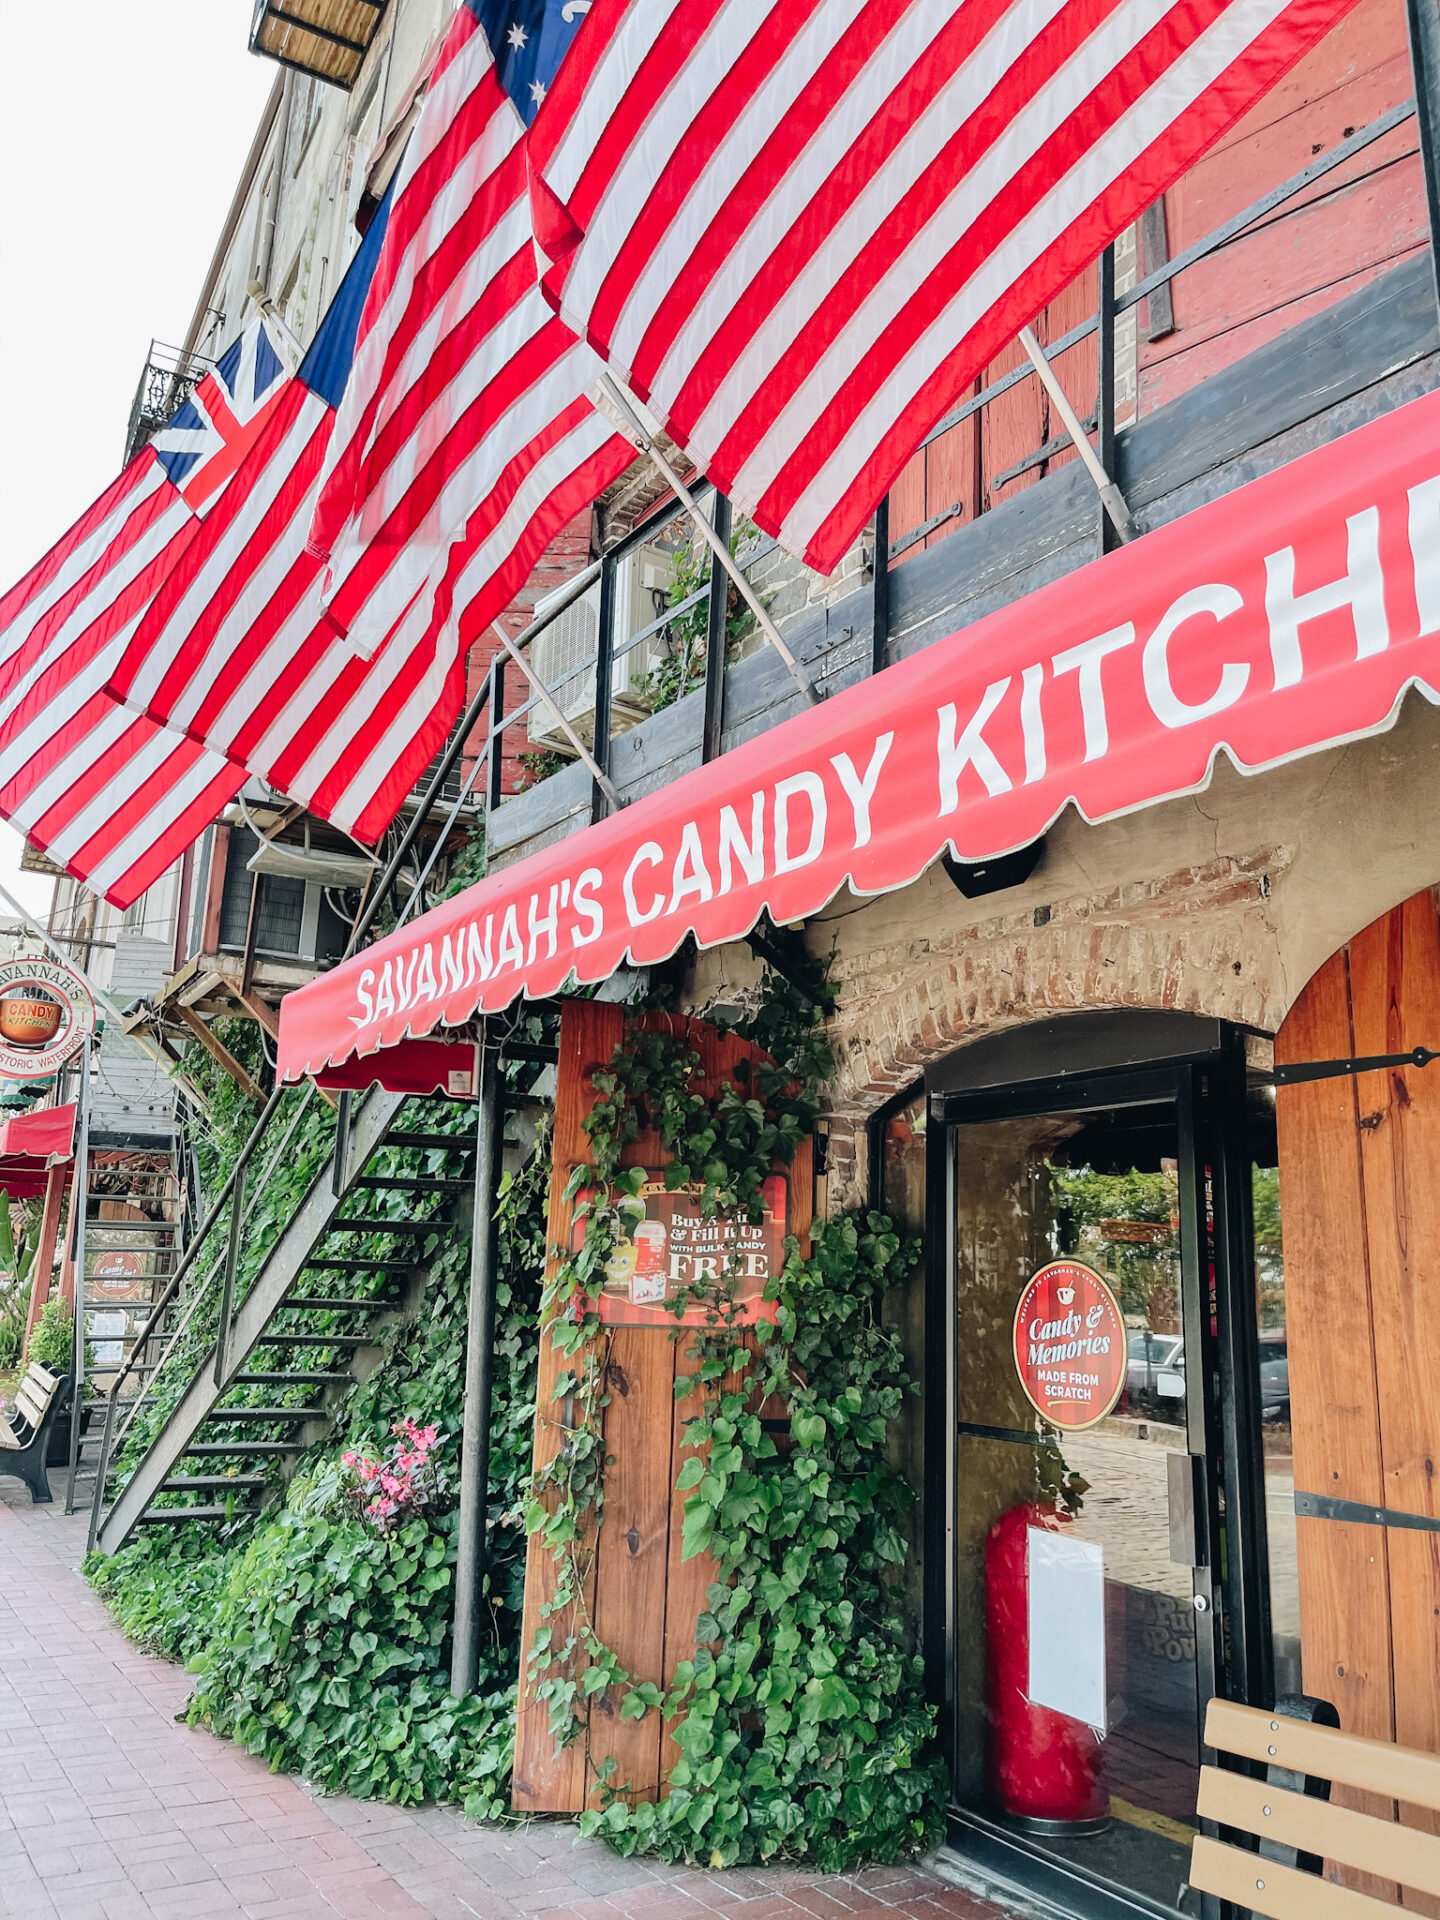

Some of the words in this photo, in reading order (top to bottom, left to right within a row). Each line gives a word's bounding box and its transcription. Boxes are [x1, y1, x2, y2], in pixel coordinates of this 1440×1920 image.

[347, 867, 604, 1029] SAVANNAH'S
[622, 731, 896, 928] CANDY
[0, 965, 83, 1000] AVANNAH'S
[9, 1003, 54, 1019] CANDY
[0, 1053, 33, 1069] STORIC
[38, 1025, 85, 1068] WATERFRONT
[671, 1213, 703, 1229] Buy
[670, 1228, 688, 1241] &
[691, 1226, 718, 1242] Fill
[740, 1224, 763, 1240] Up
[669, 1243, 693, 1253] WITH
[695, 1243, 725, 1254] BULK
[727, 1241, 767, 1251] ANDY
[668, 1252, 769, 1281] FREE
[1029, 1308, 1082, 1341] Candy
[1085, 1304, 1104, 1328] &
[1026, 1329, 1111, 1366] Memories
[1037, 1369, 1067, 1384] MADE
[1068, 1372, 1099, 1387] FROM
[1044, 1384, 1092, 1401] SCRATCH
